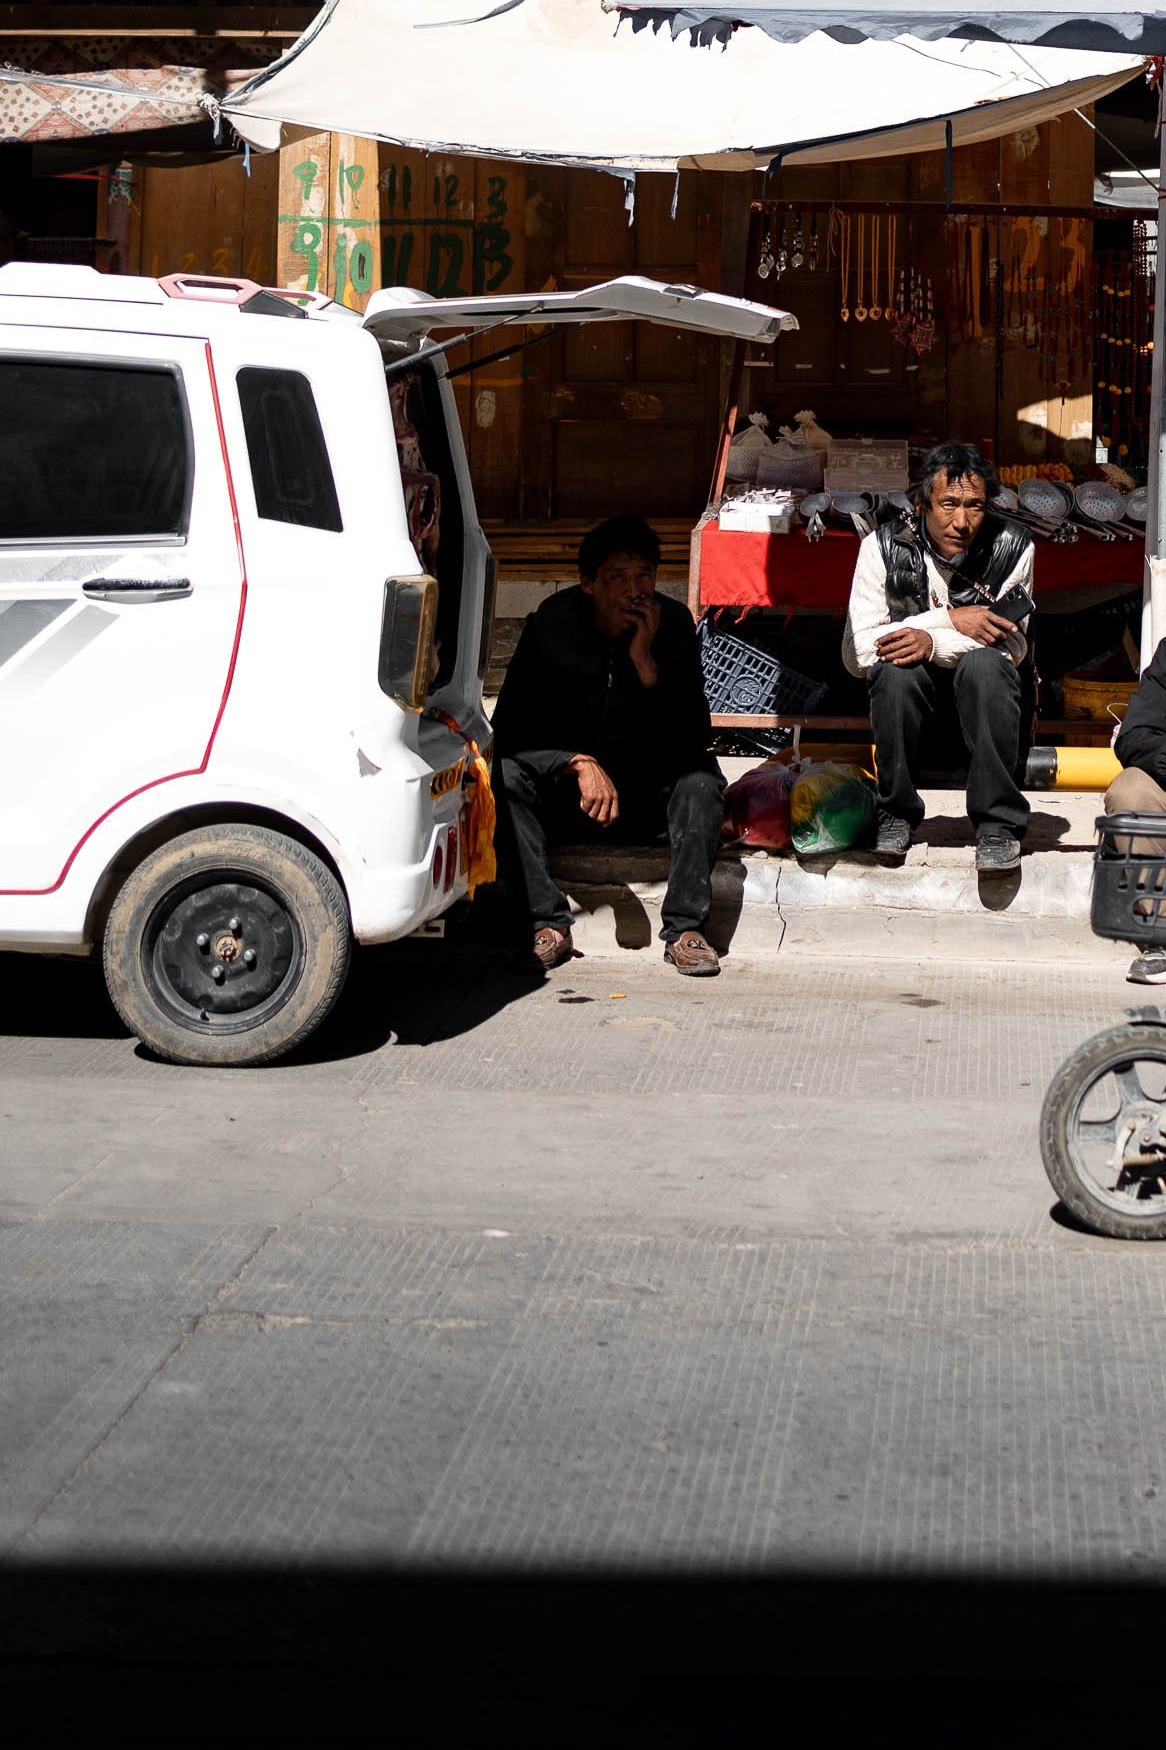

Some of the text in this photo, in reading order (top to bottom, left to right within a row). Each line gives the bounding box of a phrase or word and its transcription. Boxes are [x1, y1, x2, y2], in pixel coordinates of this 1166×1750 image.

[293, 161, 318, 200] 9
[338, 160, 364, 209] 10
[388, 164, 411, 209] 11
[433, 174, 459, 207] 12
[291, 224, 322, 306] 9
[334, 233, 373, 304] 10
[382, 233, 413, 288] 11
